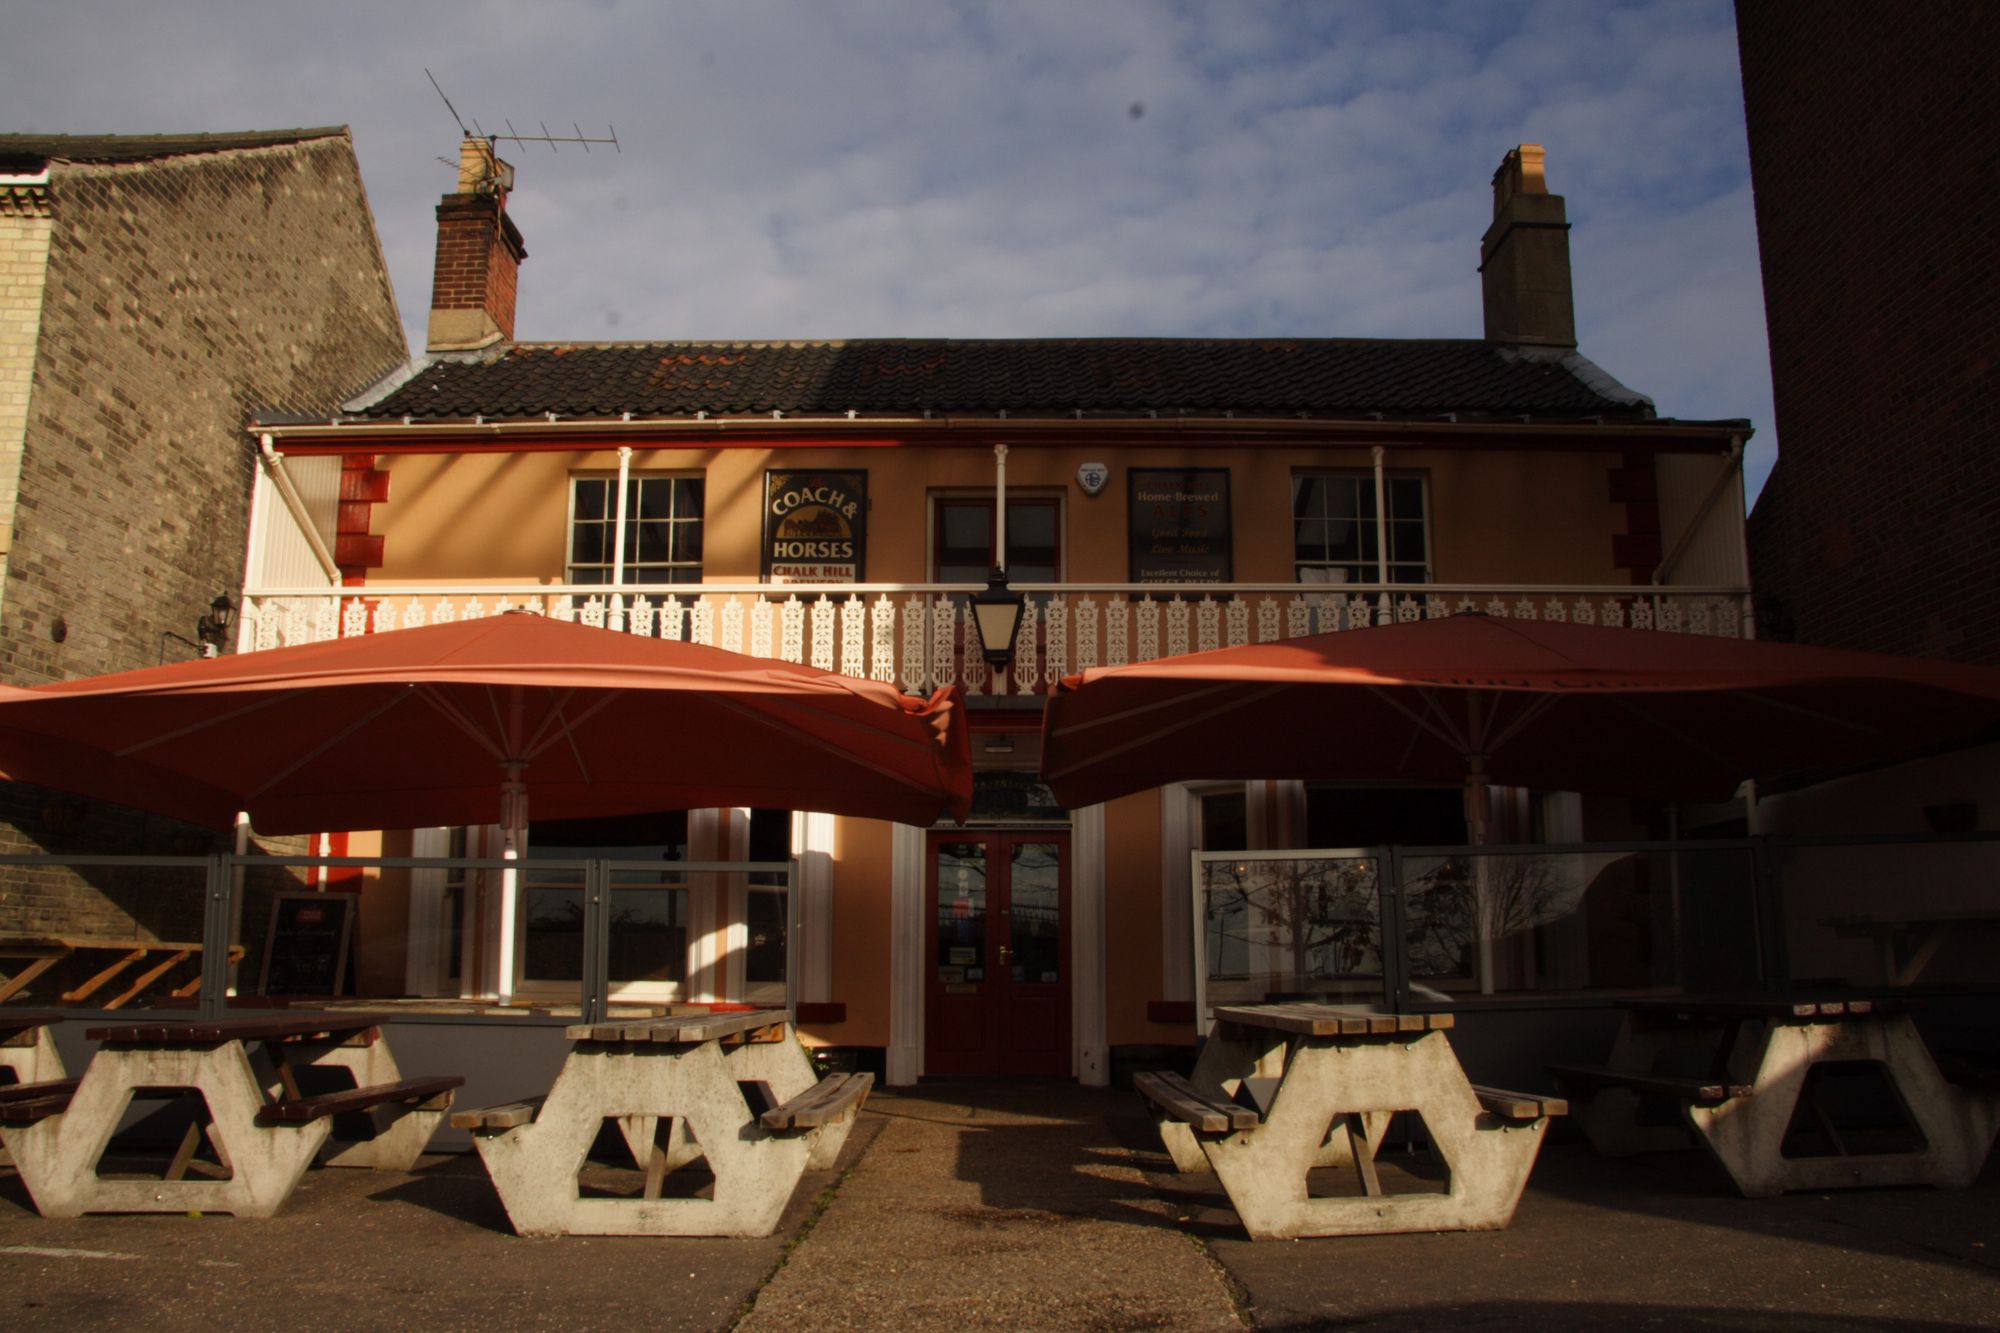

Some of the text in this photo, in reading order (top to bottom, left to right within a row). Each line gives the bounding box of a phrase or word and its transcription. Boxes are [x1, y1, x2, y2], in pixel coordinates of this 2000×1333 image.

[772, 487, 858, 519] COACH &
[773, 541, 854, 559] HORSES
[773, 565, 853, 577] CHALK HILL
[1140, 568, 1178, 577] Excellent
[1179, 568, 1207, 577] Choice
